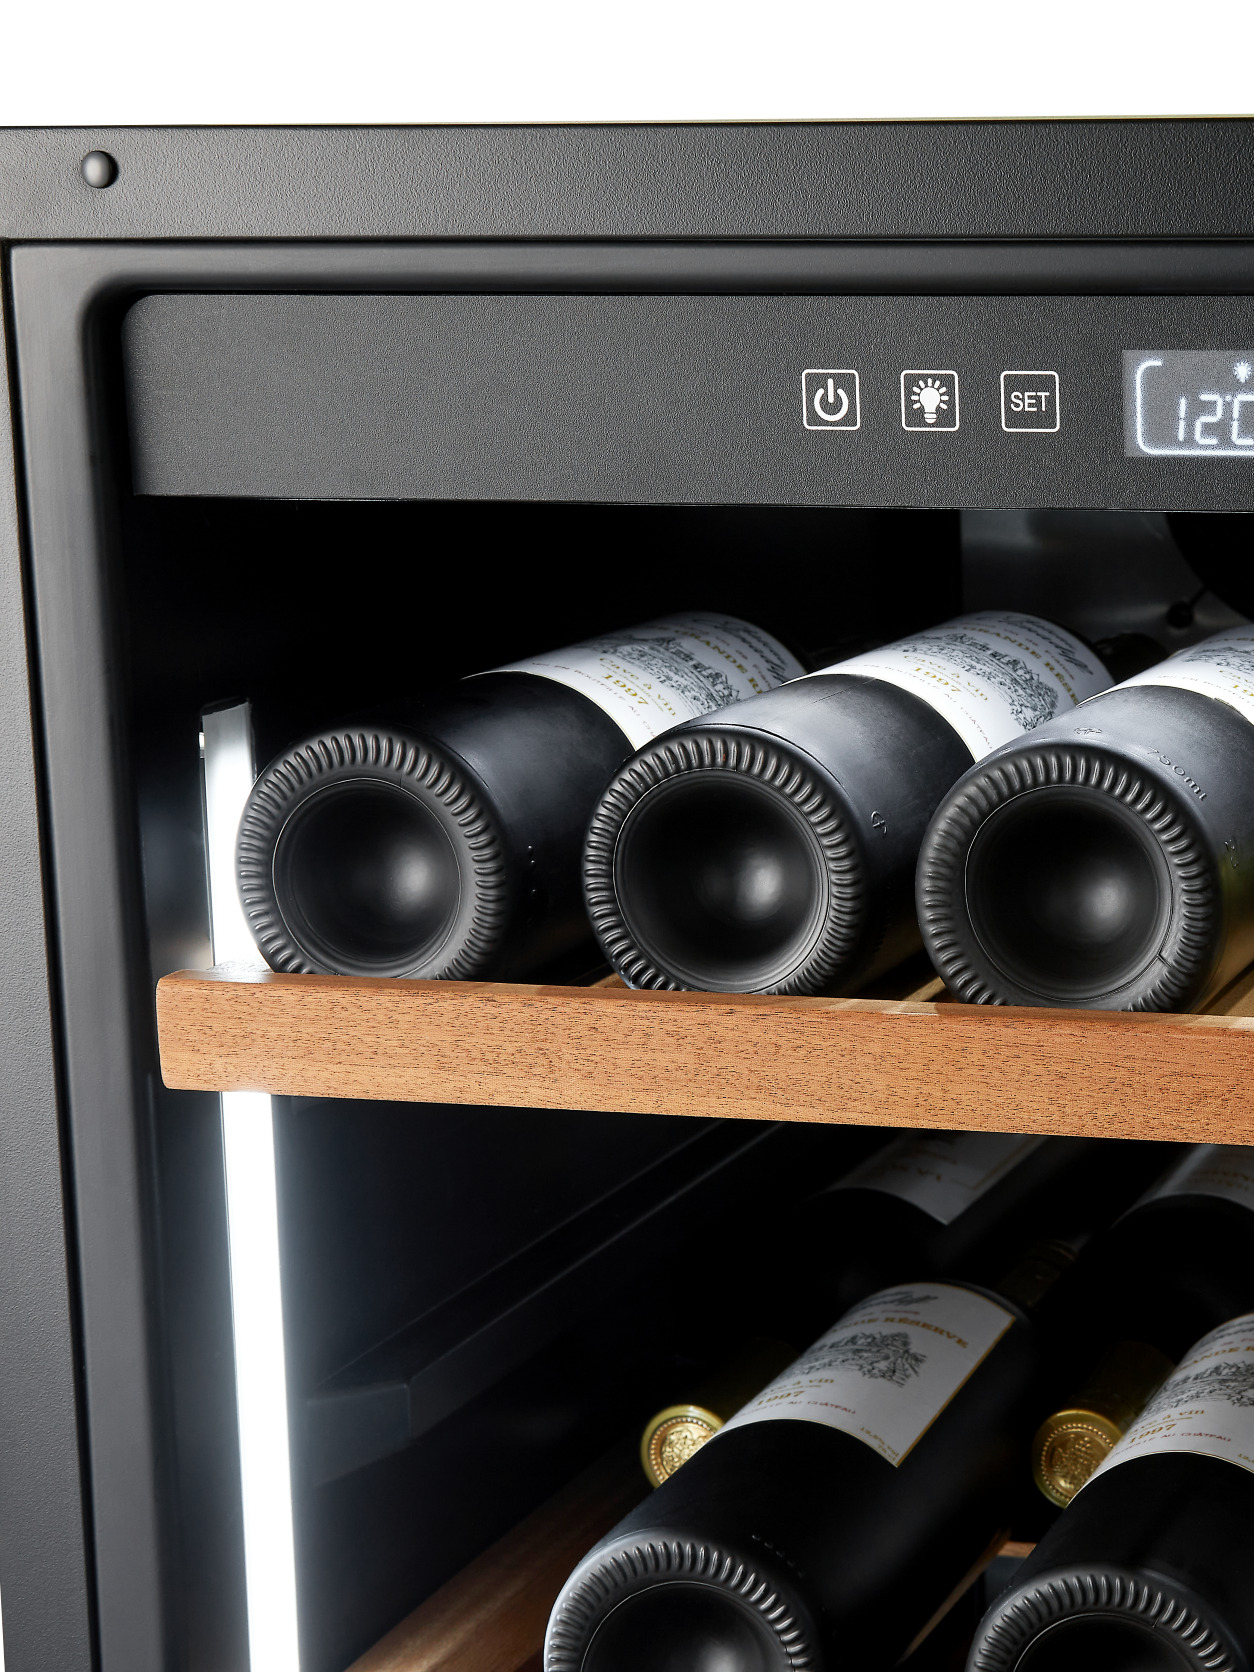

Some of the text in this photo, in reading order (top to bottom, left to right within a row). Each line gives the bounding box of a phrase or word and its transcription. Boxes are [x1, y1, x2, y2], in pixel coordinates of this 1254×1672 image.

[1009, 391, 1048, 413] SET
[603, 673, 649, 705] 1997
[914, 667, 961, 693] 1997
[1044, 661, 1079, 706] RÉSE
[657, 693, 676, 716] vin
[1147, 745, 1208, 802] 750ml
[1128, 1423, 1177, 1444] 1997
